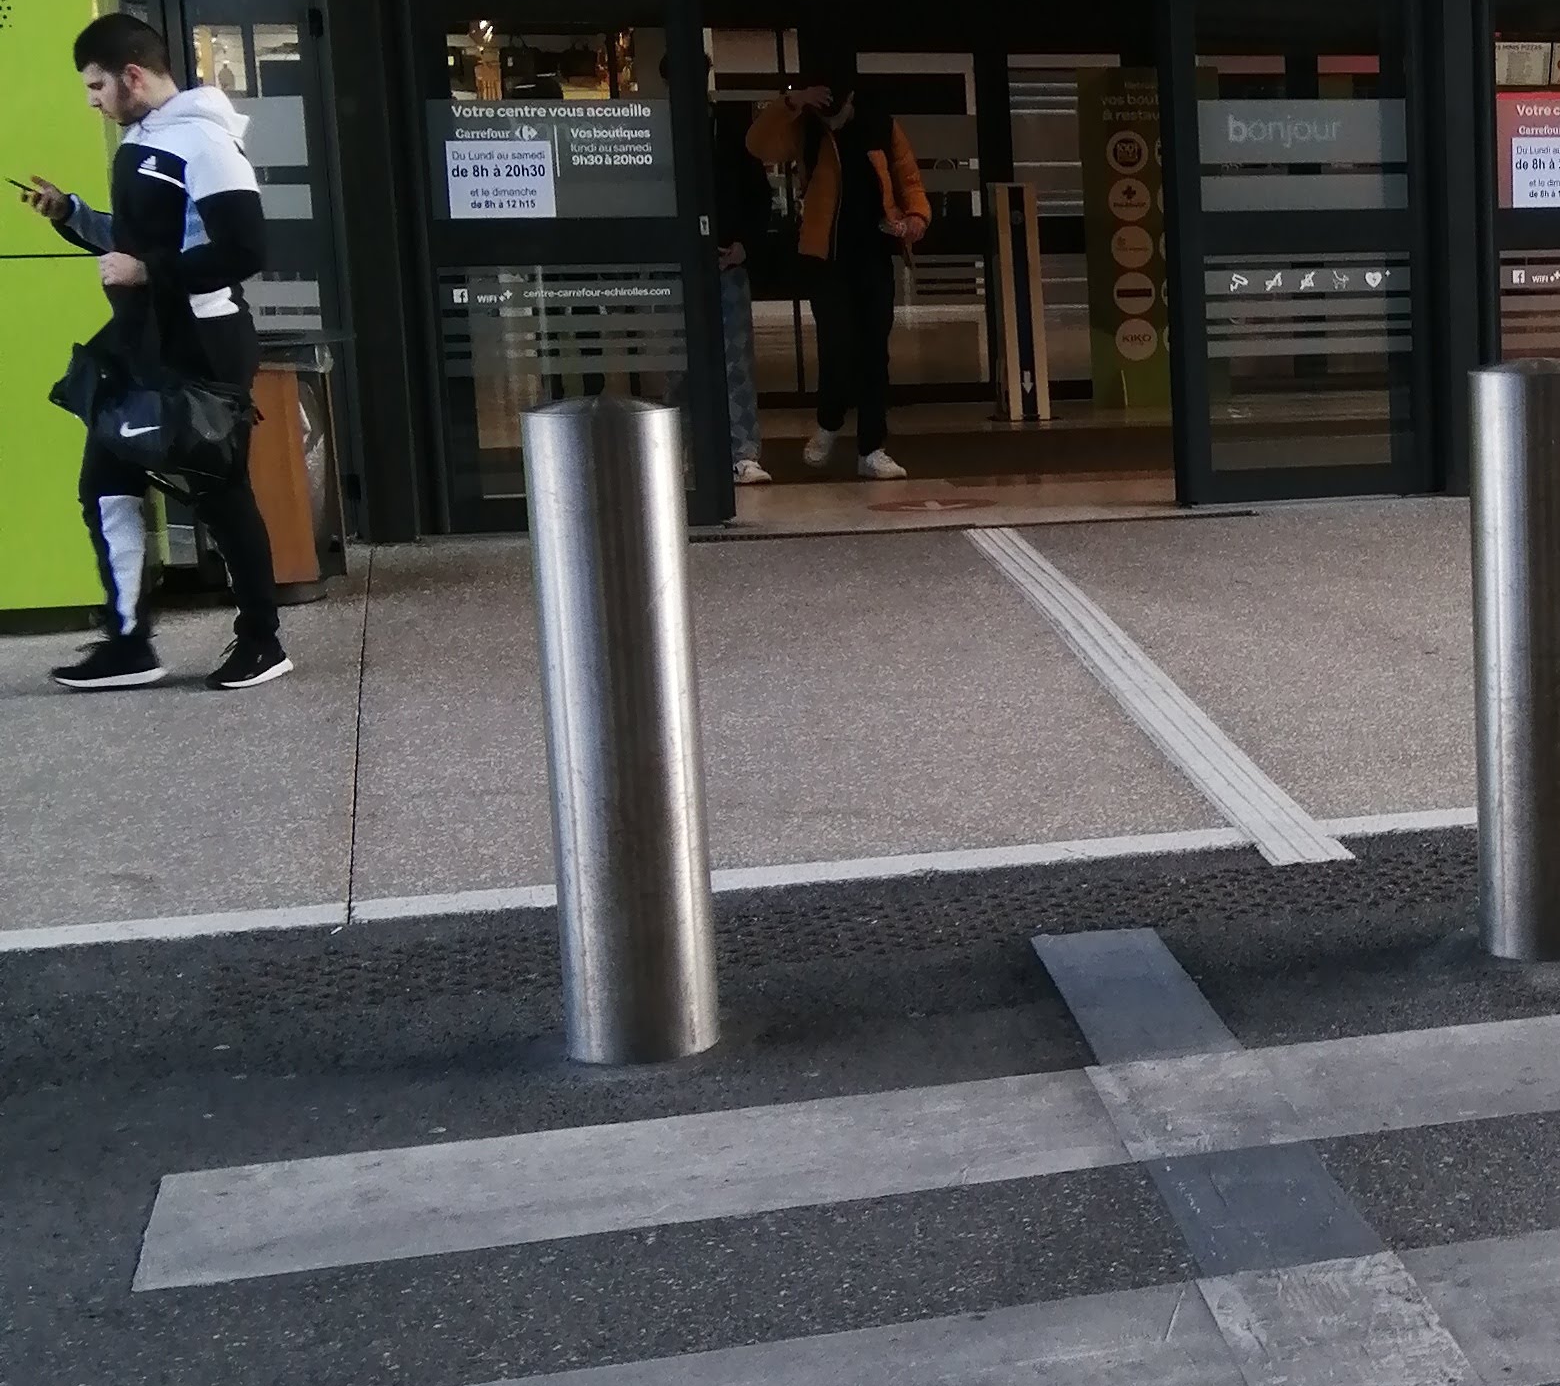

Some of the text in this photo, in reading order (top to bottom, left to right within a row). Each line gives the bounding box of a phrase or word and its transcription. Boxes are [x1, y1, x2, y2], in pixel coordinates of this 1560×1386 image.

[451, 104, 651, 118] Votre centre vous accueille
[1516, 104, 1552, 116] Votre
[455, 127, 510, 139] Carrefour
[570, 126, 651, 140] Vos boutiques
[1228, 113, 1341, 149] bonjour
[570, 143, 652, 153] lundi au samedi
[1516, 146, 1528, 155] Du
[1530, 145, 1551, 155] Lundi
[452, 150, 546, 160] Du Lundi au samedi
[572, 154, 653, 165] 9h30 à 20h00
[1515, 159, 1529, 170] de
[1532, 159, 1545, 170] 8h
[1549, 158, 1555, 170] à
[451, 164, 546, 178] de 8h à 20h30
[492, 187, 537, 196] dimanche
[523, 287, 671, 298] centre-carrefour-echirolles.com
